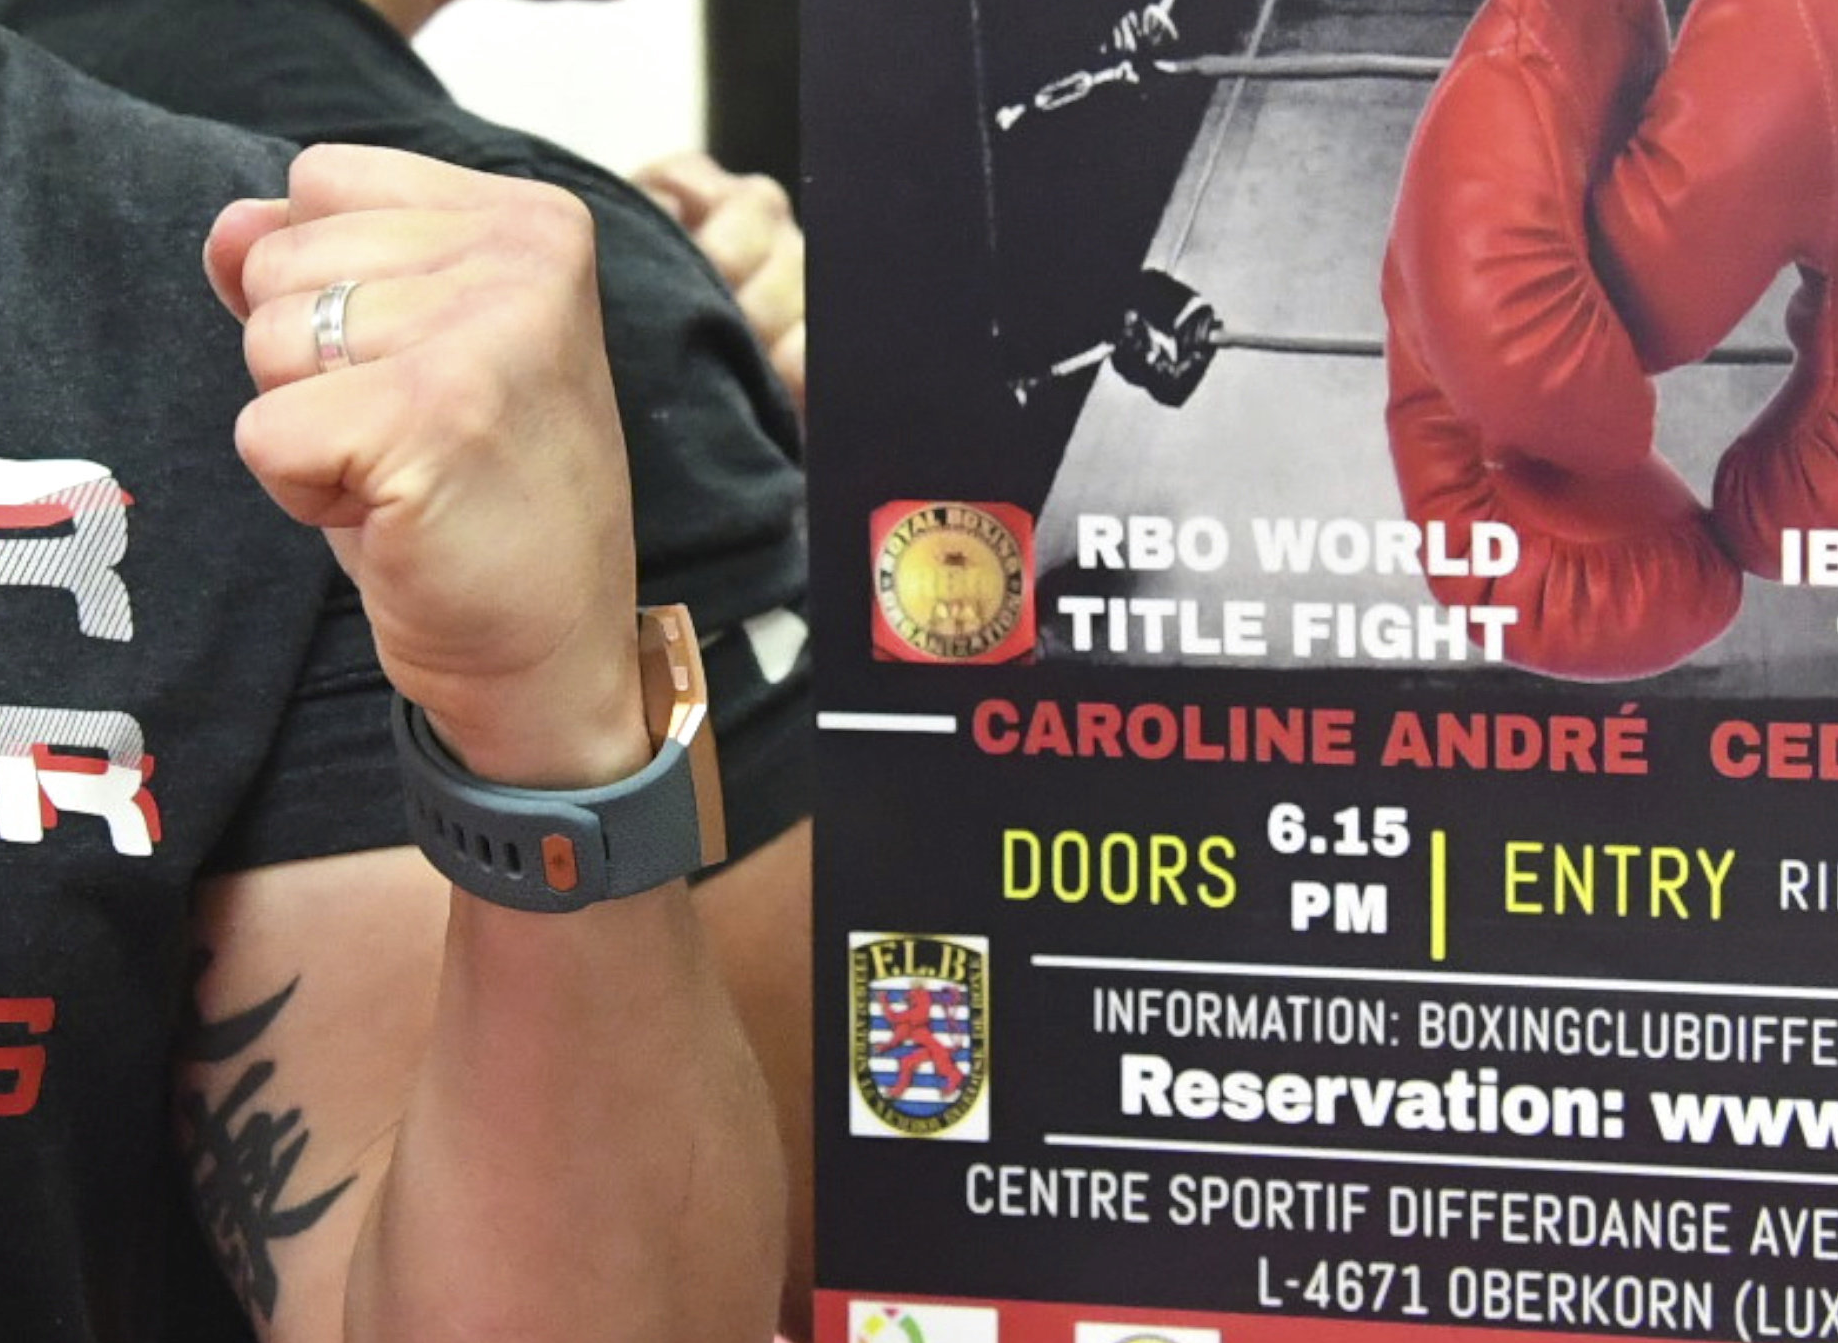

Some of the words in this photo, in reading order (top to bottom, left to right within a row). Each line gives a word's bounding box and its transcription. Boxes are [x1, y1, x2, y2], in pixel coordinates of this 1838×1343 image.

[1077, 514, 1227, 572] RBO
[1253, 520, 1519, 576] WORLD
[1058, 596, 1275, 655] TITLE
[1291, 603, 1519, 661] FIGHT
[971, 698, 1356, 766] CAROLINE
[1380, 702, 1649, 774] ANDRÉ
[1267, 803, 1411, 858] 6.15
[1003, 829, 1238, 909] DOORS
[1504, 840, 1736, 920] ENTRY
[1290, 881, 1389, 933] PM
[1093, 988, 1400, 1048] INFORMATION:
[1119, 1054, 1626, 1140] Reservation:
[965, 1164, 1151, 1222] CENTRE
[1167, 1174, 1369, 1232] SPORTIF
[1388, 1184, 1731, 1254] DIFFERDANGE
[1257, 1257, 1430, 1314] L-4671
[1447, 1268, 1713, 1330] OBERKORN
